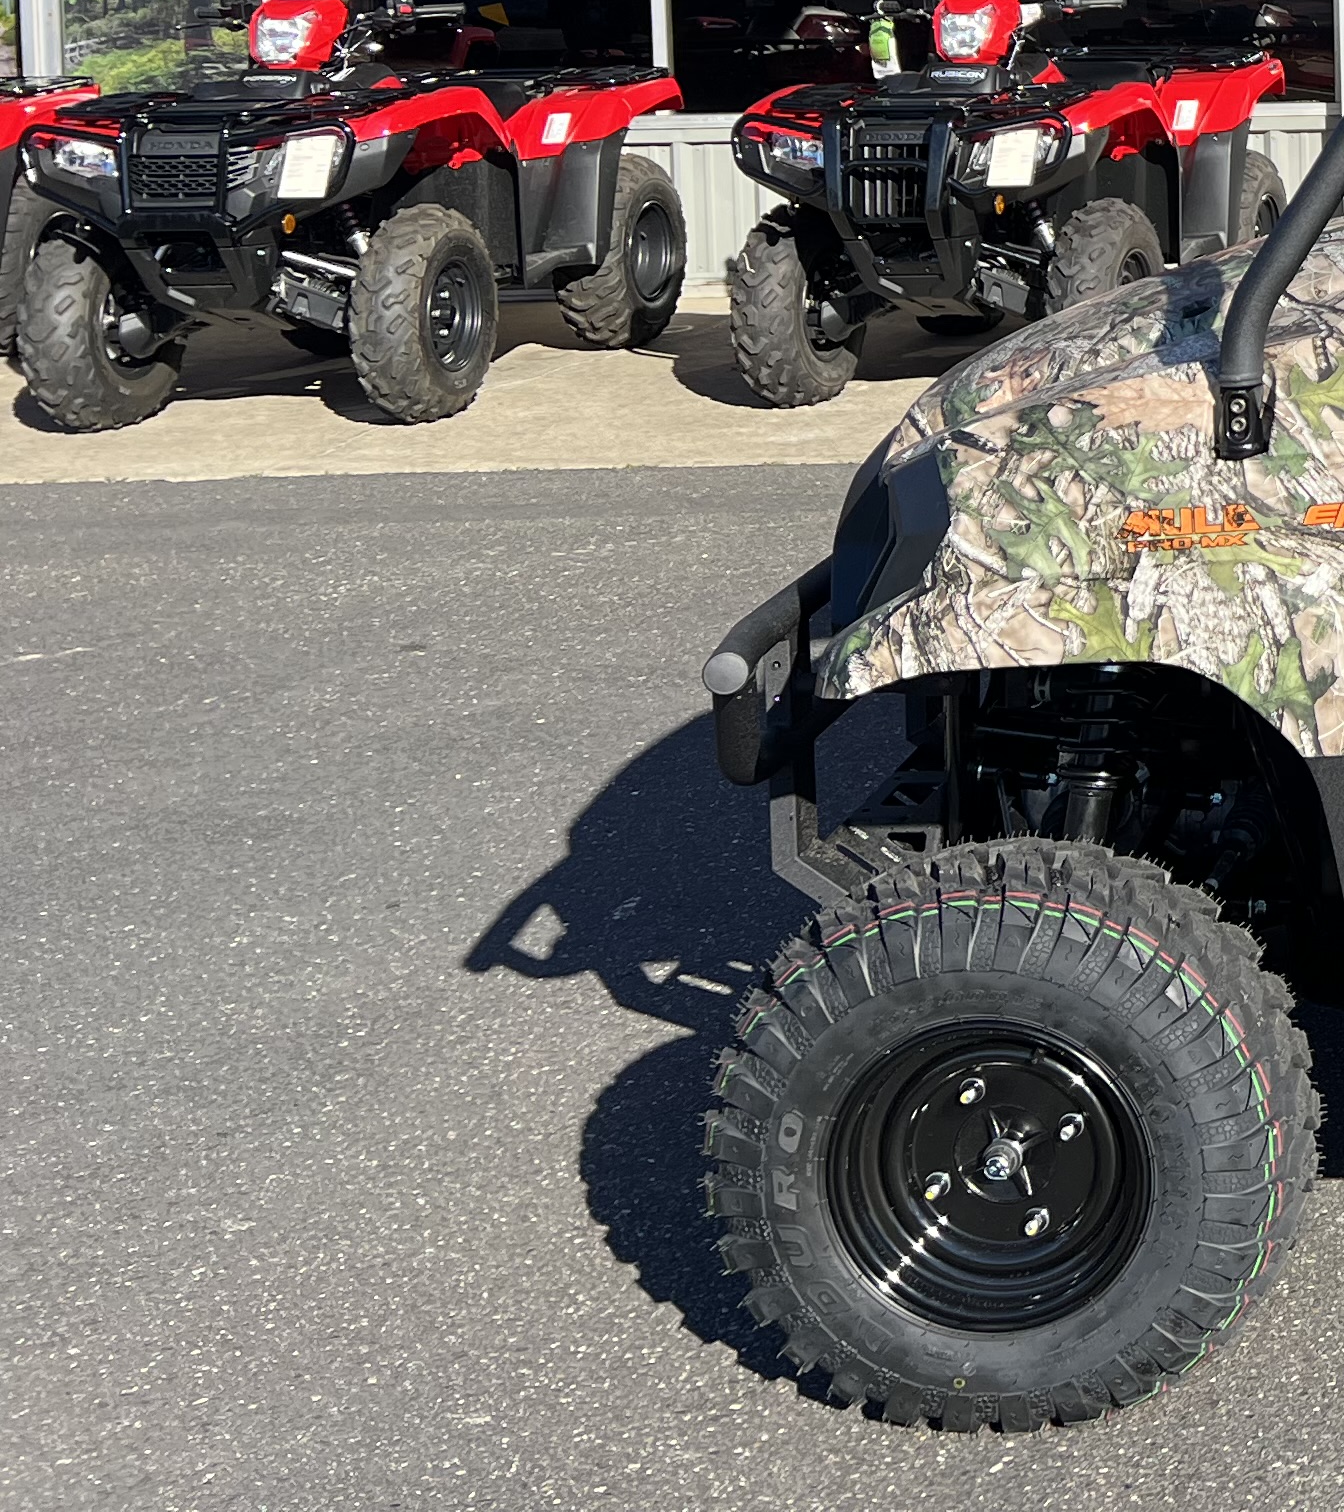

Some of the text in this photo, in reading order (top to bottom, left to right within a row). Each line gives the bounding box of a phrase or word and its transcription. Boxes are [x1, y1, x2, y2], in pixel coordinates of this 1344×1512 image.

[930, 70, 986, 80] RUBICON
[149, 140, 215, 151] HONDA
[1116, 504, 1261, 538] MULE
